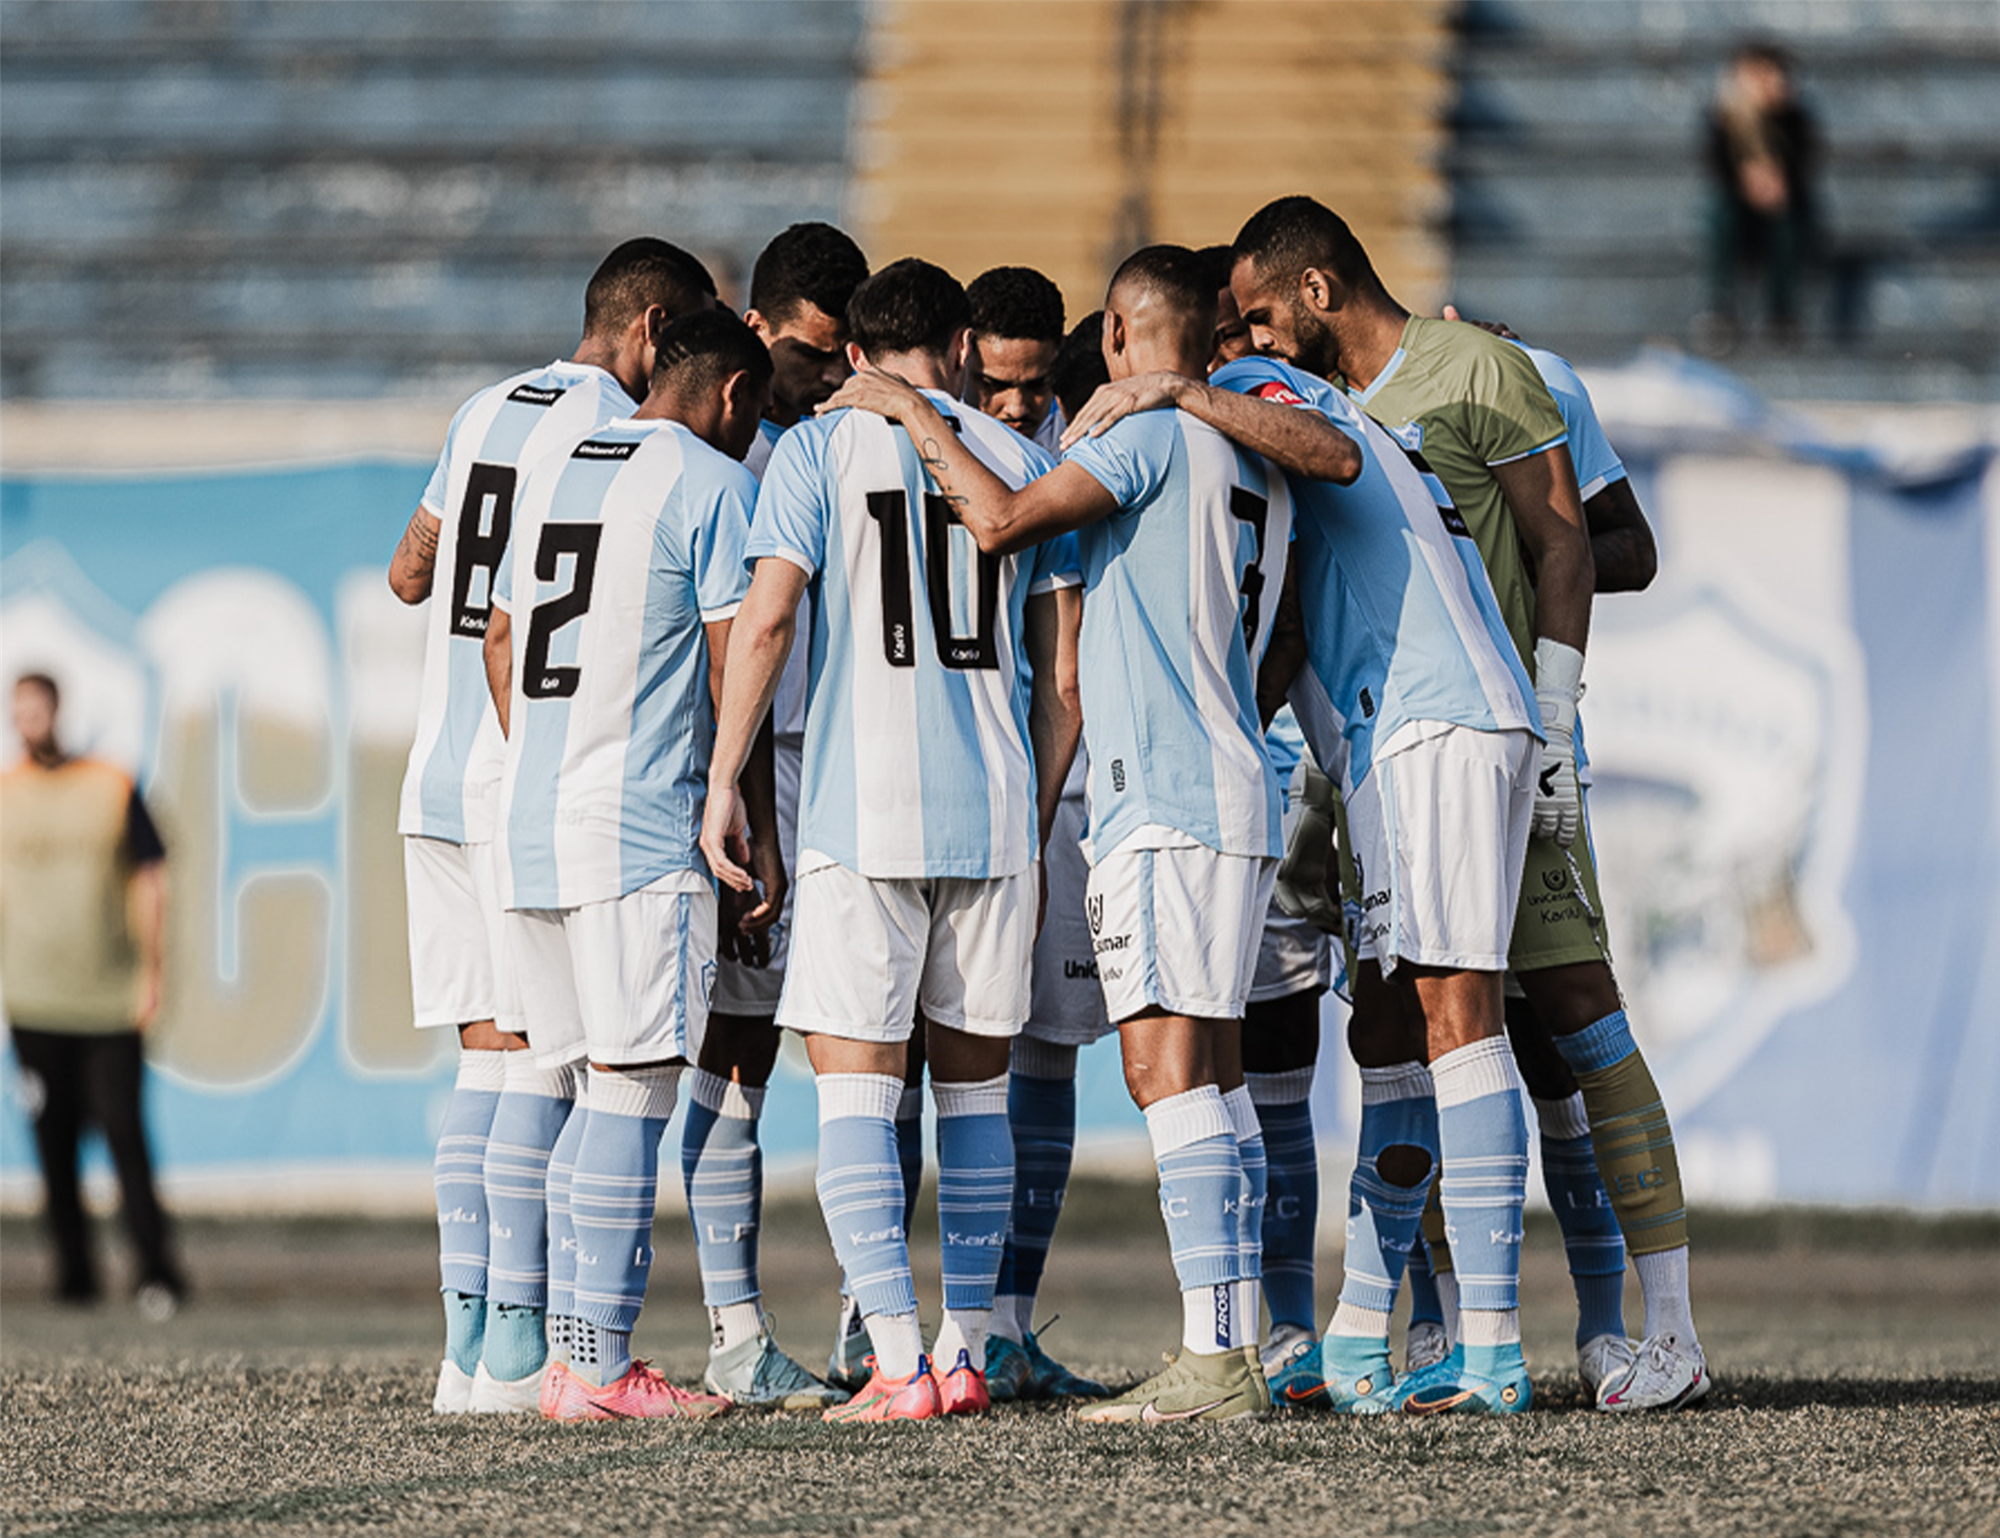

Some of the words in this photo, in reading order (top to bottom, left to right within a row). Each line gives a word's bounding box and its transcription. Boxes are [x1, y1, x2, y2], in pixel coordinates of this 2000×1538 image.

[866, 489, 1000, 670] 10
[522, 523, 604, 699] 2
[1527, 891, 1578, 907] UniCesum
[1065, 959, 1099, 979] UniC
[1216, 1284, 1228, 1338] PROS
